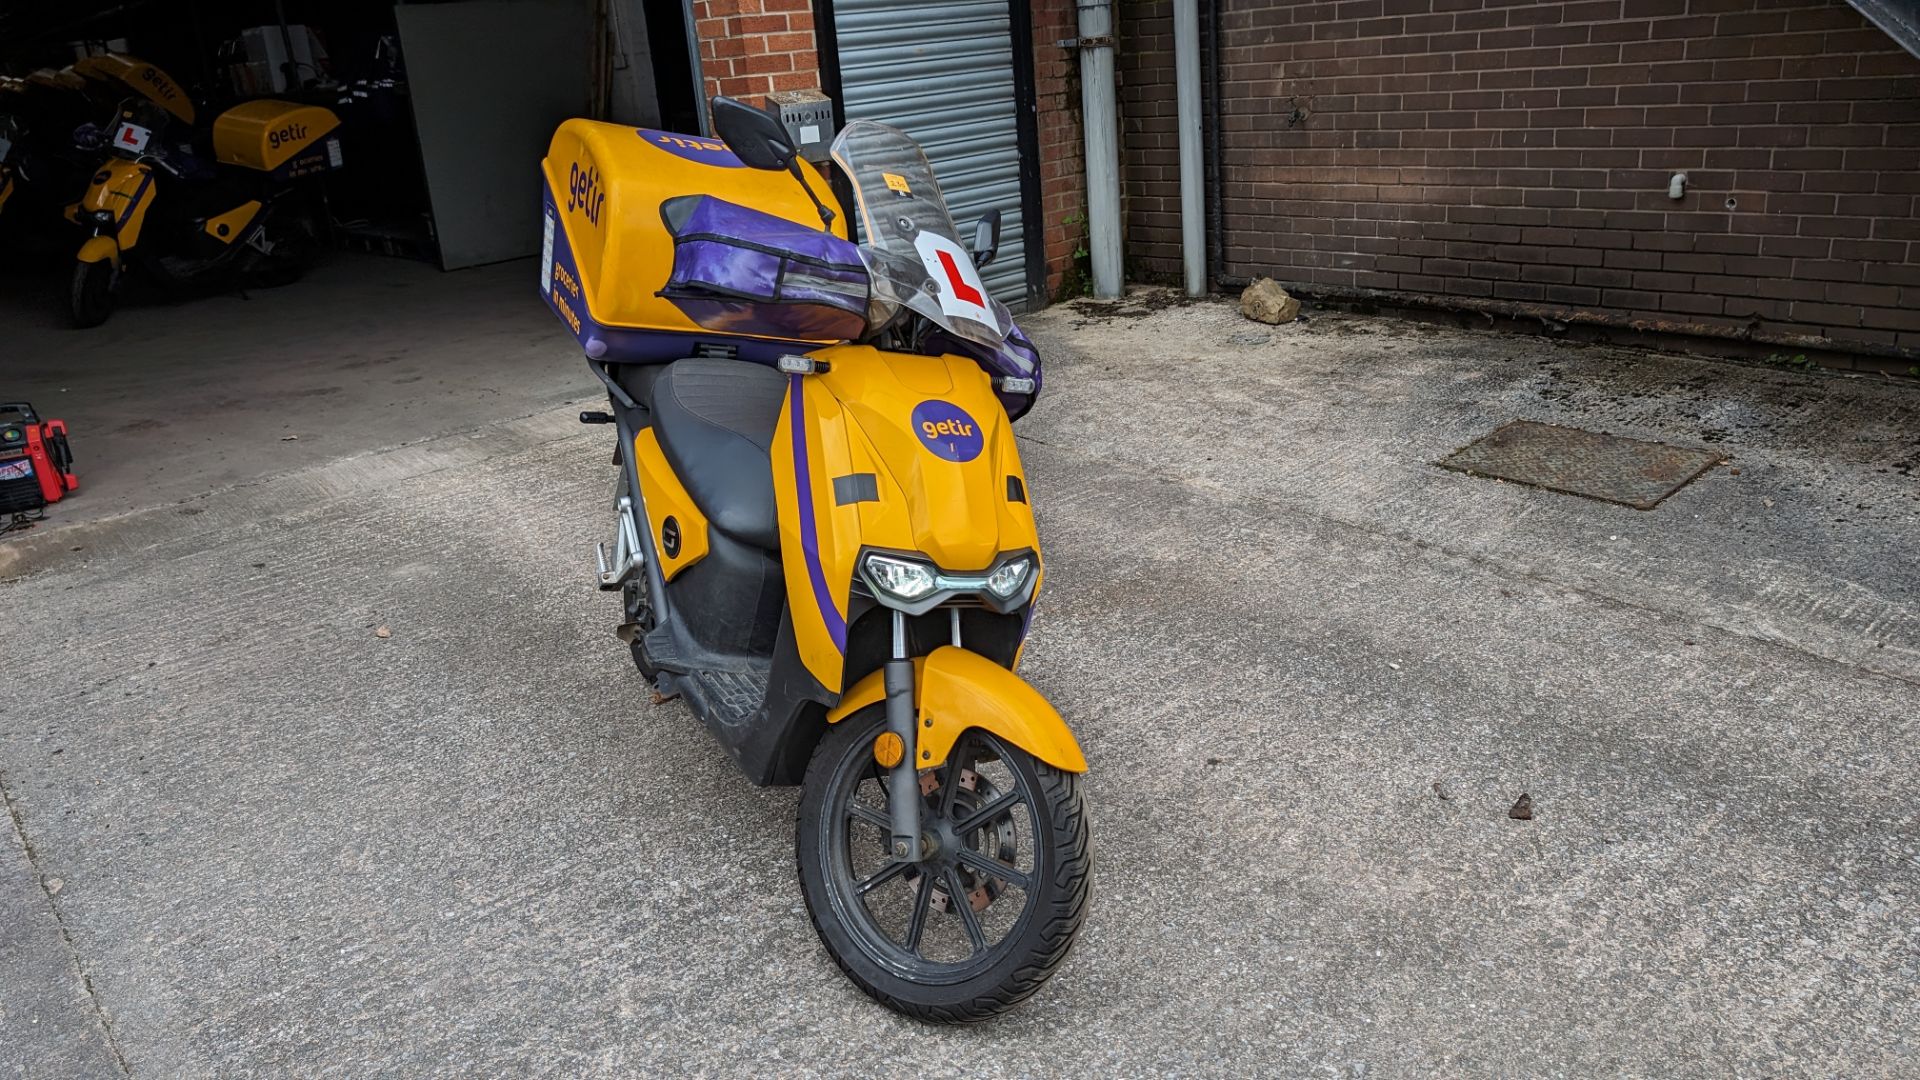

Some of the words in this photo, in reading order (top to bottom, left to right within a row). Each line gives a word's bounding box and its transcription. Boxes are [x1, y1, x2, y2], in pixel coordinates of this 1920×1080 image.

[122, 127, 138, 145] L
[269, 123, 308, 149] getir
[658, 135, 732, 153] etir
[568, 162, 605, 228] getir
[935, 249, 986, 309] L
[558, 296, 581, 336] minutes
[922, 418, 973, 440] getir
